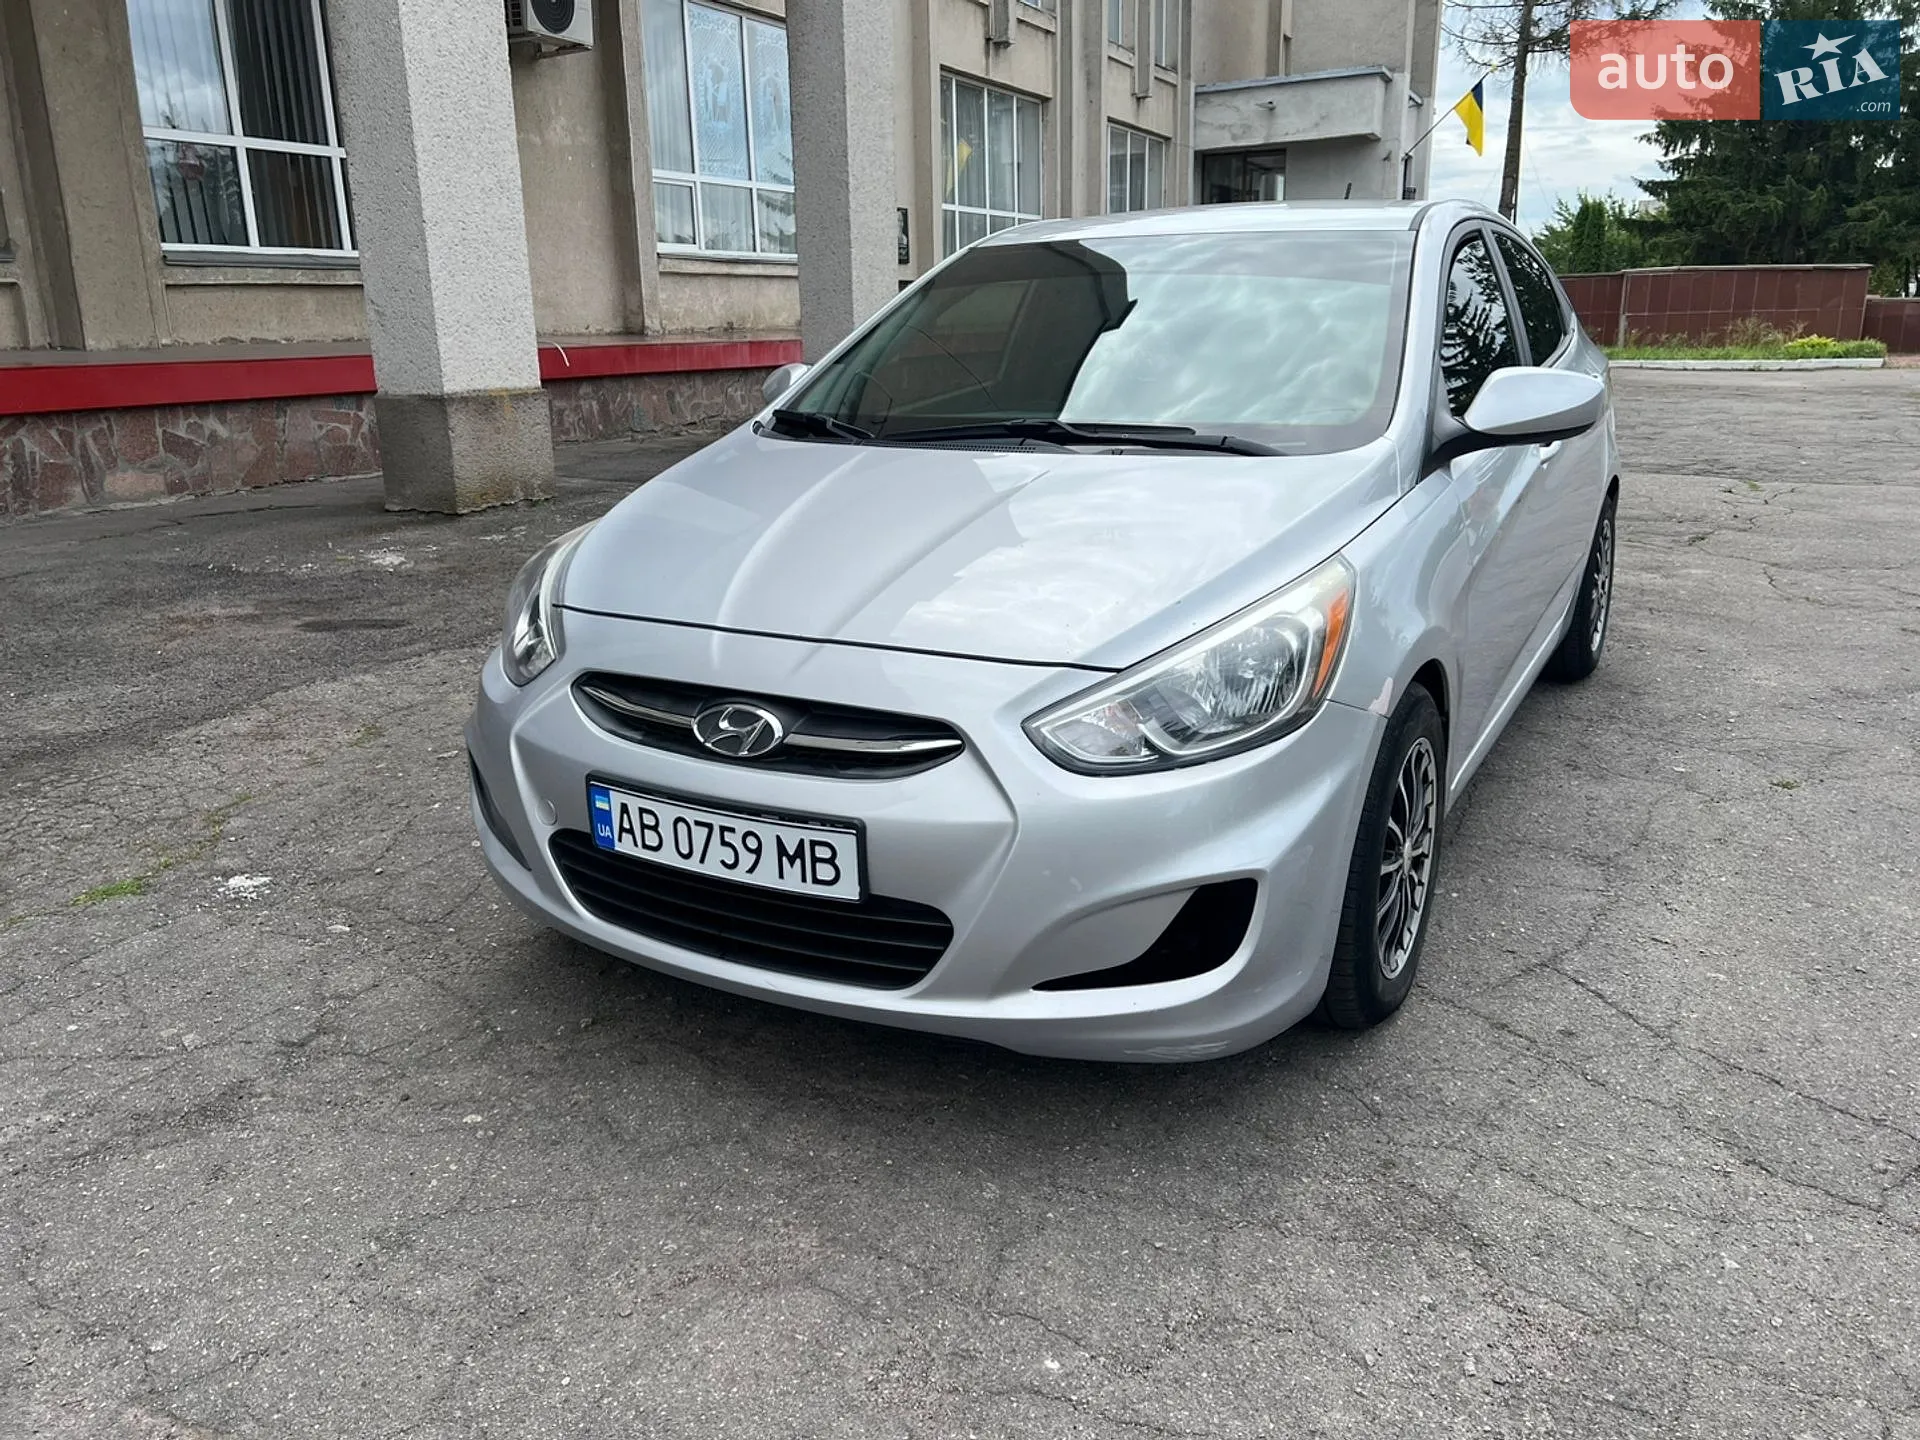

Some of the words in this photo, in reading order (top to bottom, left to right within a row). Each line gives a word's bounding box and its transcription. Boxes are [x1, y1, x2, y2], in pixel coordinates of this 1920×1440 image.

[598, 824, 612, 838] UA
[617, 802, 663, 852] AB
[672, 816, 763, 874] 0759
[776, 834, 841, 886] MB
